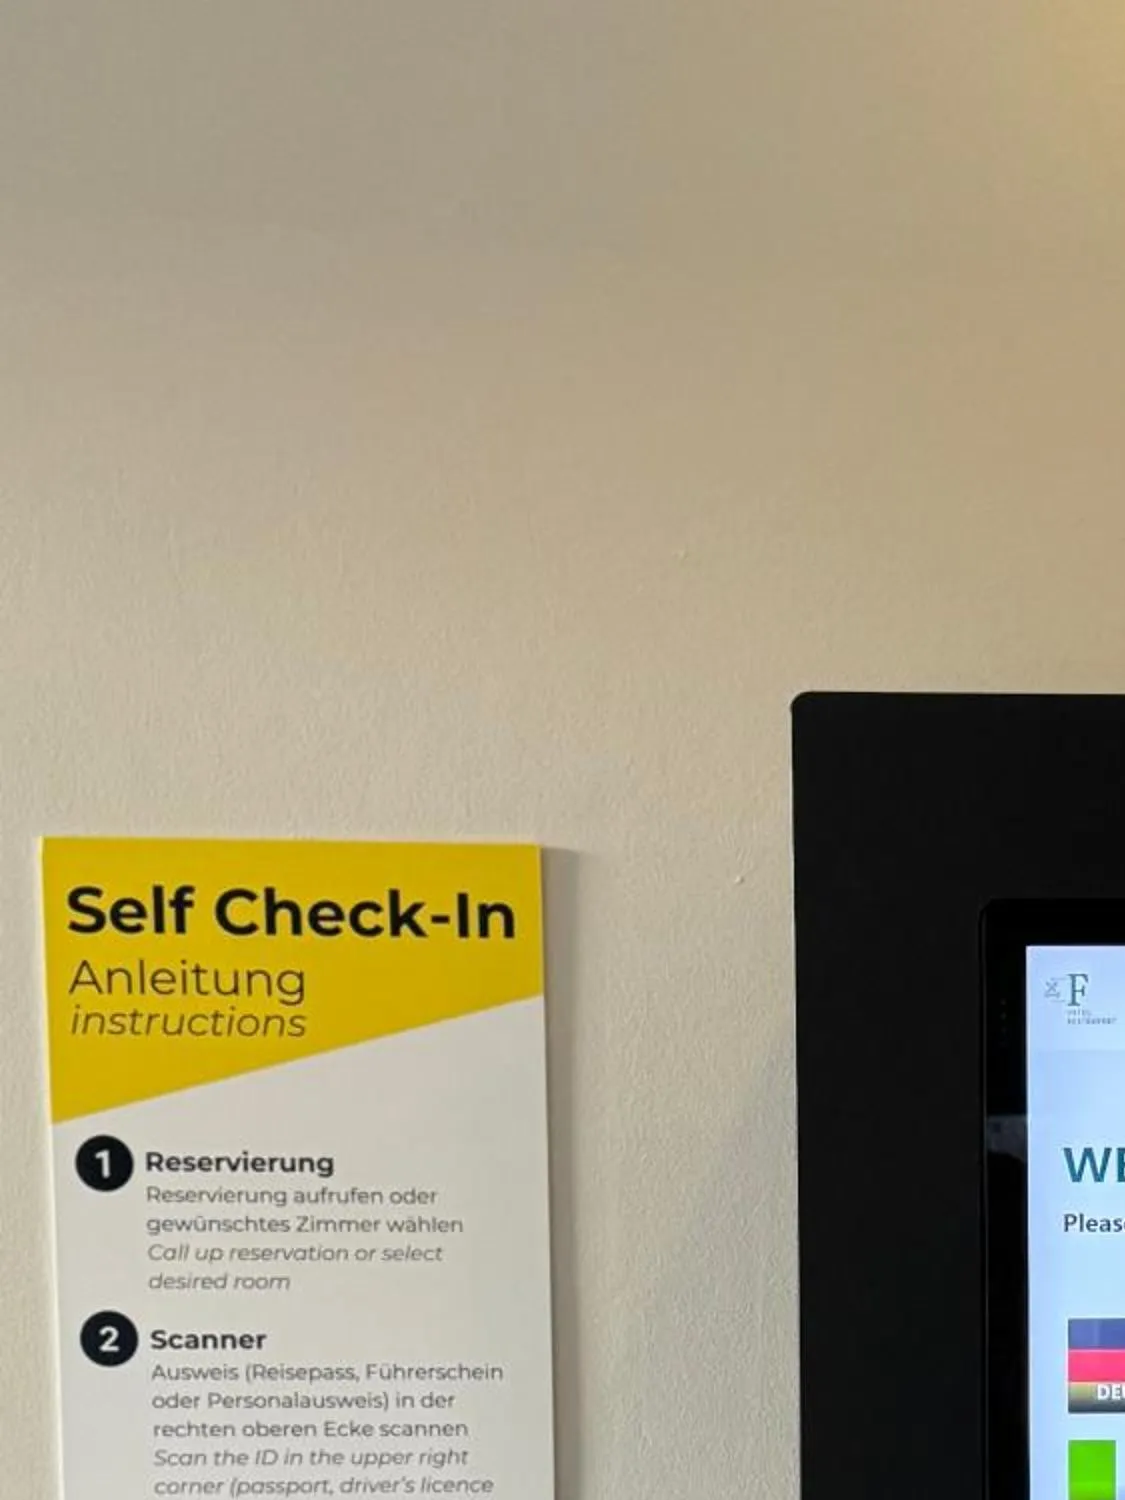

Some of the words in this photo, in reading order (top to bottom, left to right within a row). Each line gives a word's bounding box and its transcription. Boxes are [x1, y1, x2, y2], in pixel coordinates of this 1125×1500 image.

[68, 885, 195, 934] Self
[216, 887, 514, 938] Check-In
[69, 959, 304, 1006] Anleitung
[72, 1004, 306, 1037] instructions
[96, 1150, 110, 1177] 1
[146, 1151, 334, 1178] Reservierung
[147, 1186, 287, 1208] Reservierung
[294, 1187, 383, 1204] aufrufen
[389, 1188, 437, 1204] oder
[146, 1216, 291, 1236] gewünschtes
[296, 1216, 380, 1232] Zimmer
[386, 1216, 463, 1232] wählen
[148, 1244, 190, 1261] Call
[195, 1248, 224, 1264] up
[229, 1245, 348, 1261] reservation
[354, 1248, 376, 1261] or
[381, 1245, 443, 1261] select
[148, 1272, 228, 1289] desired
[233, 1277, 290, 1290] room
[100, 1326, 119, 1351] 2
[151, 1330, 266, 1349] Scanner
[152, 1364, 240, 1380] Ausweis
[246, 1364, 360, 1385] (Reisepass,
[366, 1364, 503, 1381] Führerschein
[152, 1392, 200, 1409] oder
[208, 1392, 388, 1411] Personalausweis)
[396, 1392, 414, 1408] in
[420, 1392, 455, 1408] der
[154, 1421, 235, 1437] rechten
[242, 1421, 317, 1437] oberen
[324, 1420, 374, 1437] Ecke
[379, 1424, 468, 1437] scannen
[154, 1449, 207, 1466] Scan
[214, 1450, 249, 1466] the
[255, 1449, 279, 1466] ID
[284, 1448, 303, 1465] in
[310, 1449, 345, 1465] the
[351, 1452, 413, 1469] upper
[420, 1448, 468, 1469] right
[154, 1481, 224, 1495] corner
[230, 1477, 334, 1498] (passport,
[420, 1477, 494, 1493] licence
